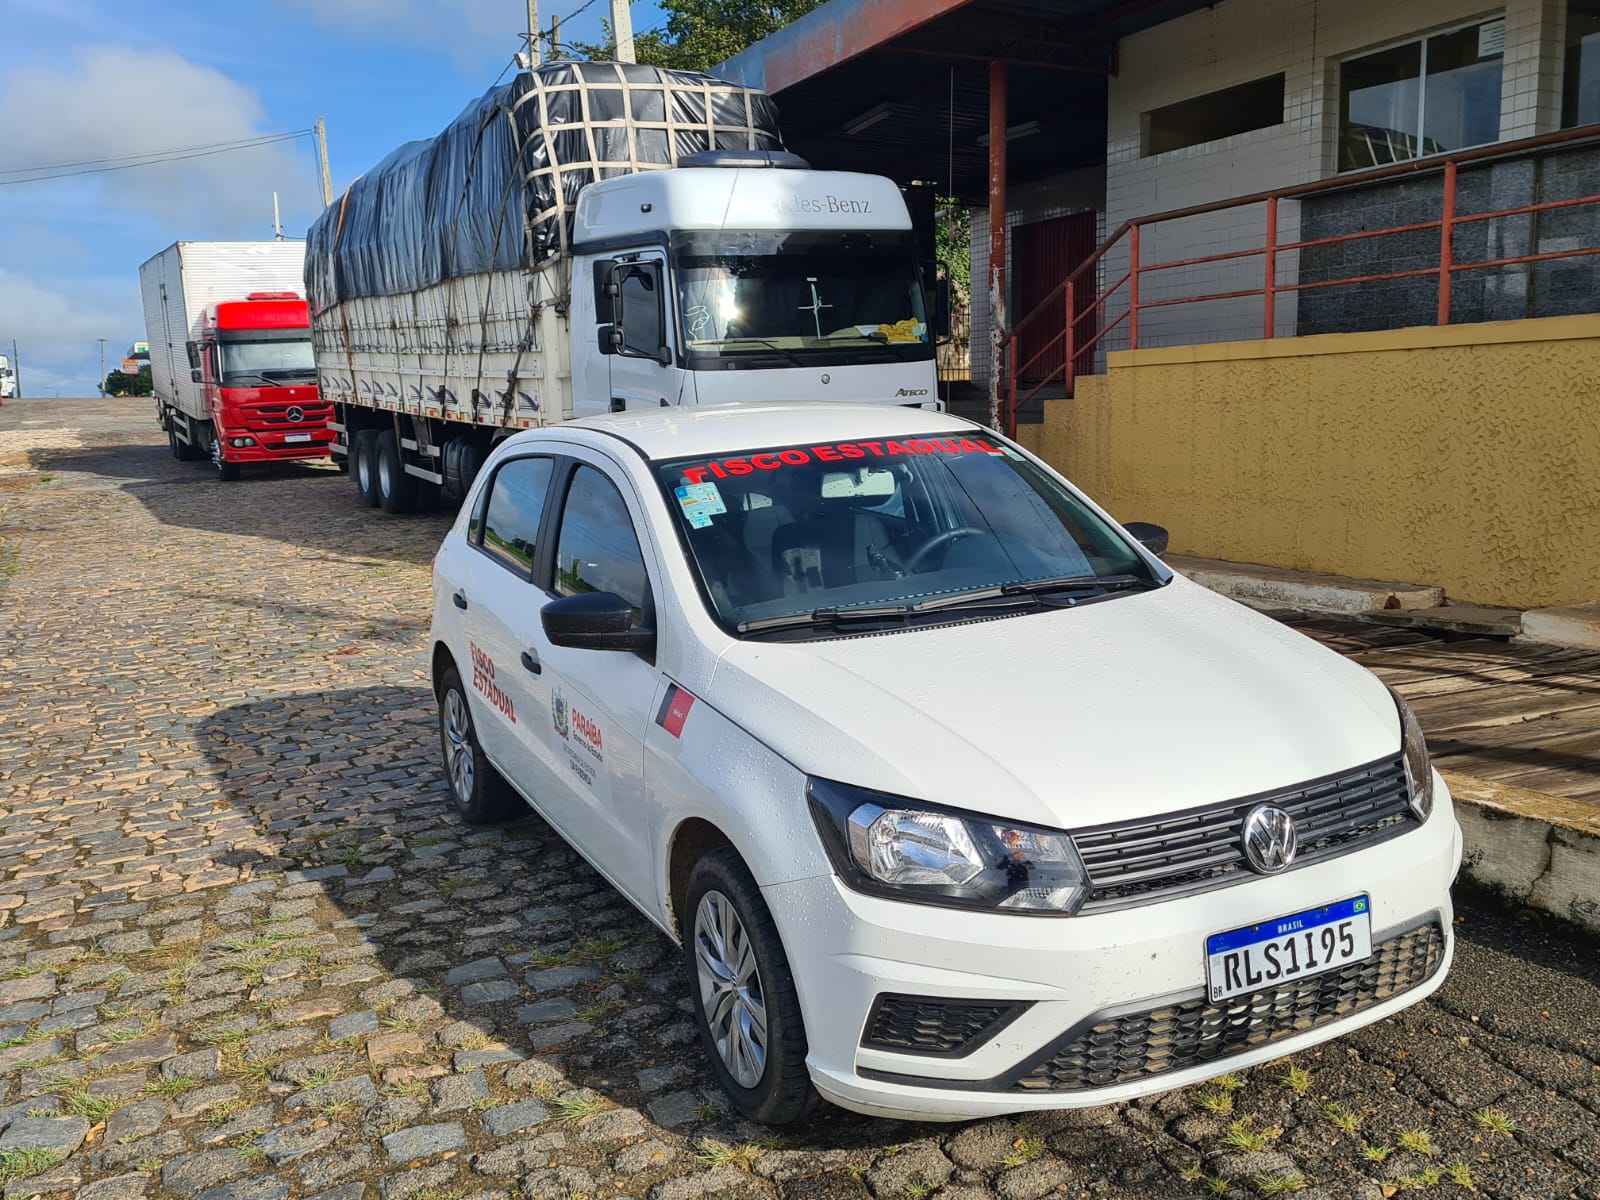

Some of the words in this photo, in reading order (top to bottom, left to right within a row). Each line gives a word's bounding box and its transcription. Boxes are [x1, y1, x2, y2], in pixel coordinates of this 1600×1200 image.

[682, 449, 810, 485] FISCO
[810, 438, 1006, 462] ESTADUAL
[470, 640, 496, 681] FISCO
[472, 665, 517, 724] ESTADUAL
[572, 707, 603, 751] PARAÍBA
[1277, 920, 1303, 934] BRASIL
[1224, 921, 1354, 991] RLS1I95
[1213, 985, 1224, 999] BR
